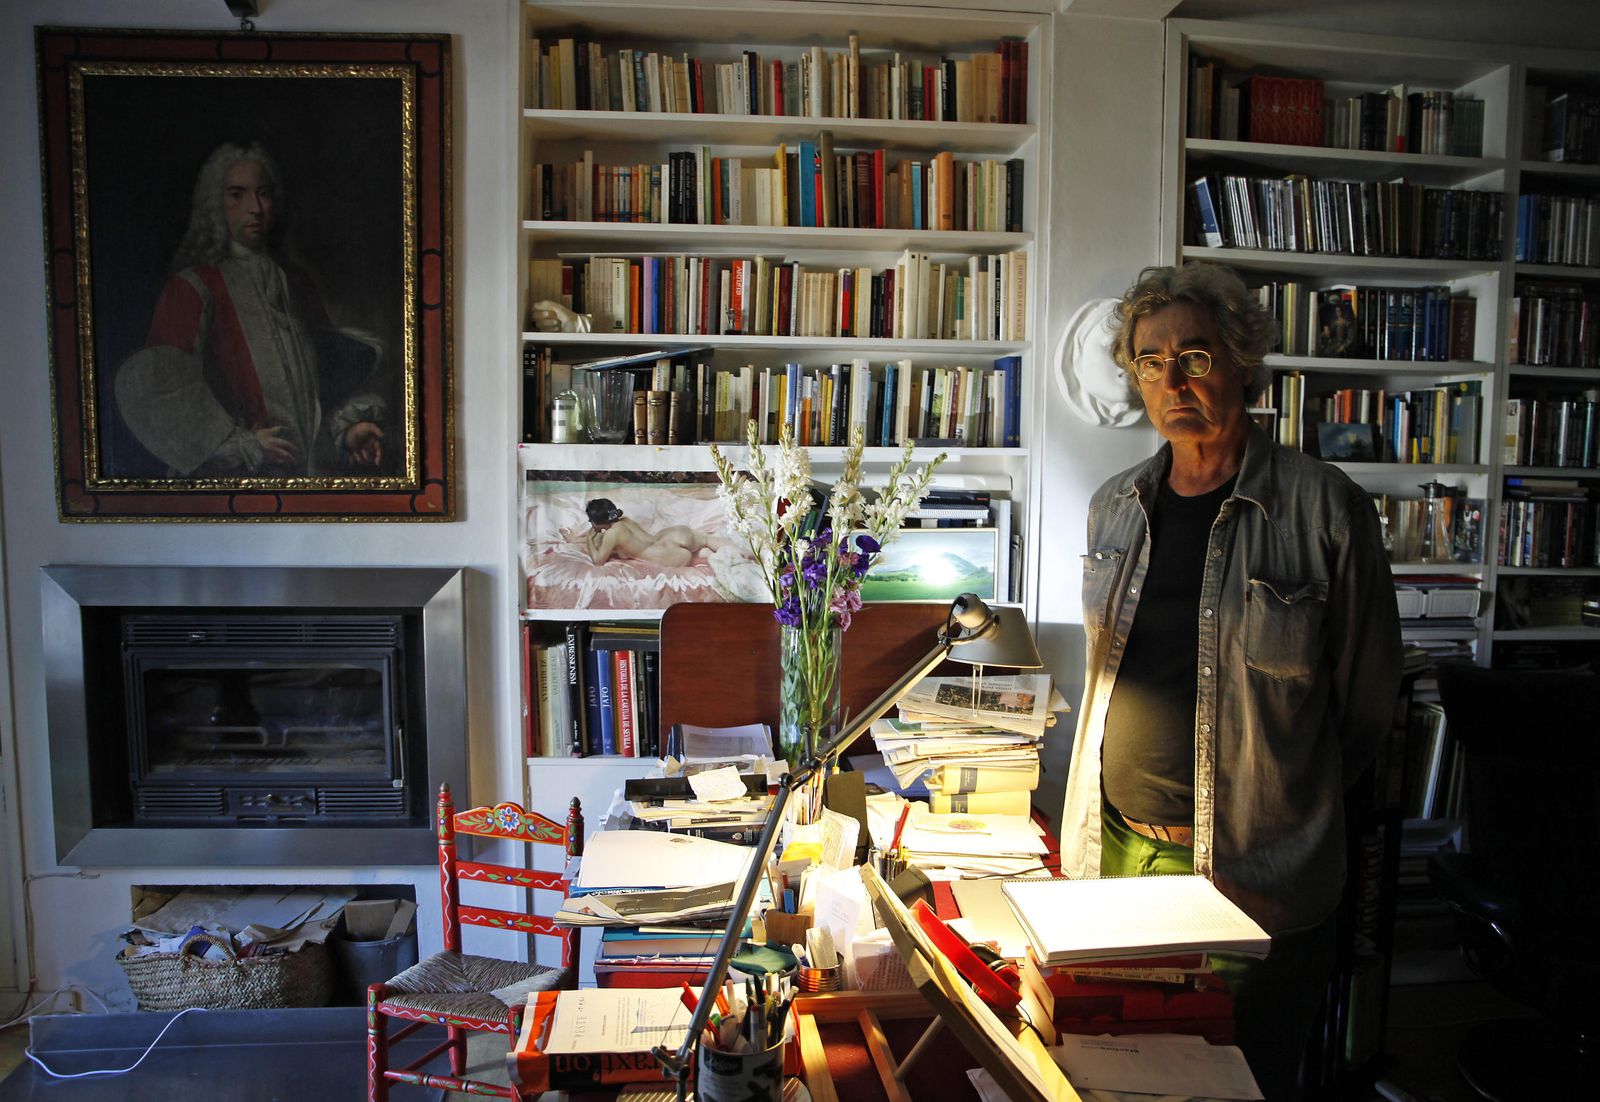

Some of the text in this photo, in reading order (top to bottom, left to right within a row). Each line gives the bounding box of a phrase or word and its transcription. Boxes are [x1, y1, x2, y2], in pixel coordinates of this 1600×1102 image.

[567, 634, 577, 685] EXPRESSIONISM
[619, 659, 628, 683] HISTORIA
[621, 698, 630, 720] CARTUJA
[623, 728, 631, 749] SEVILLA
